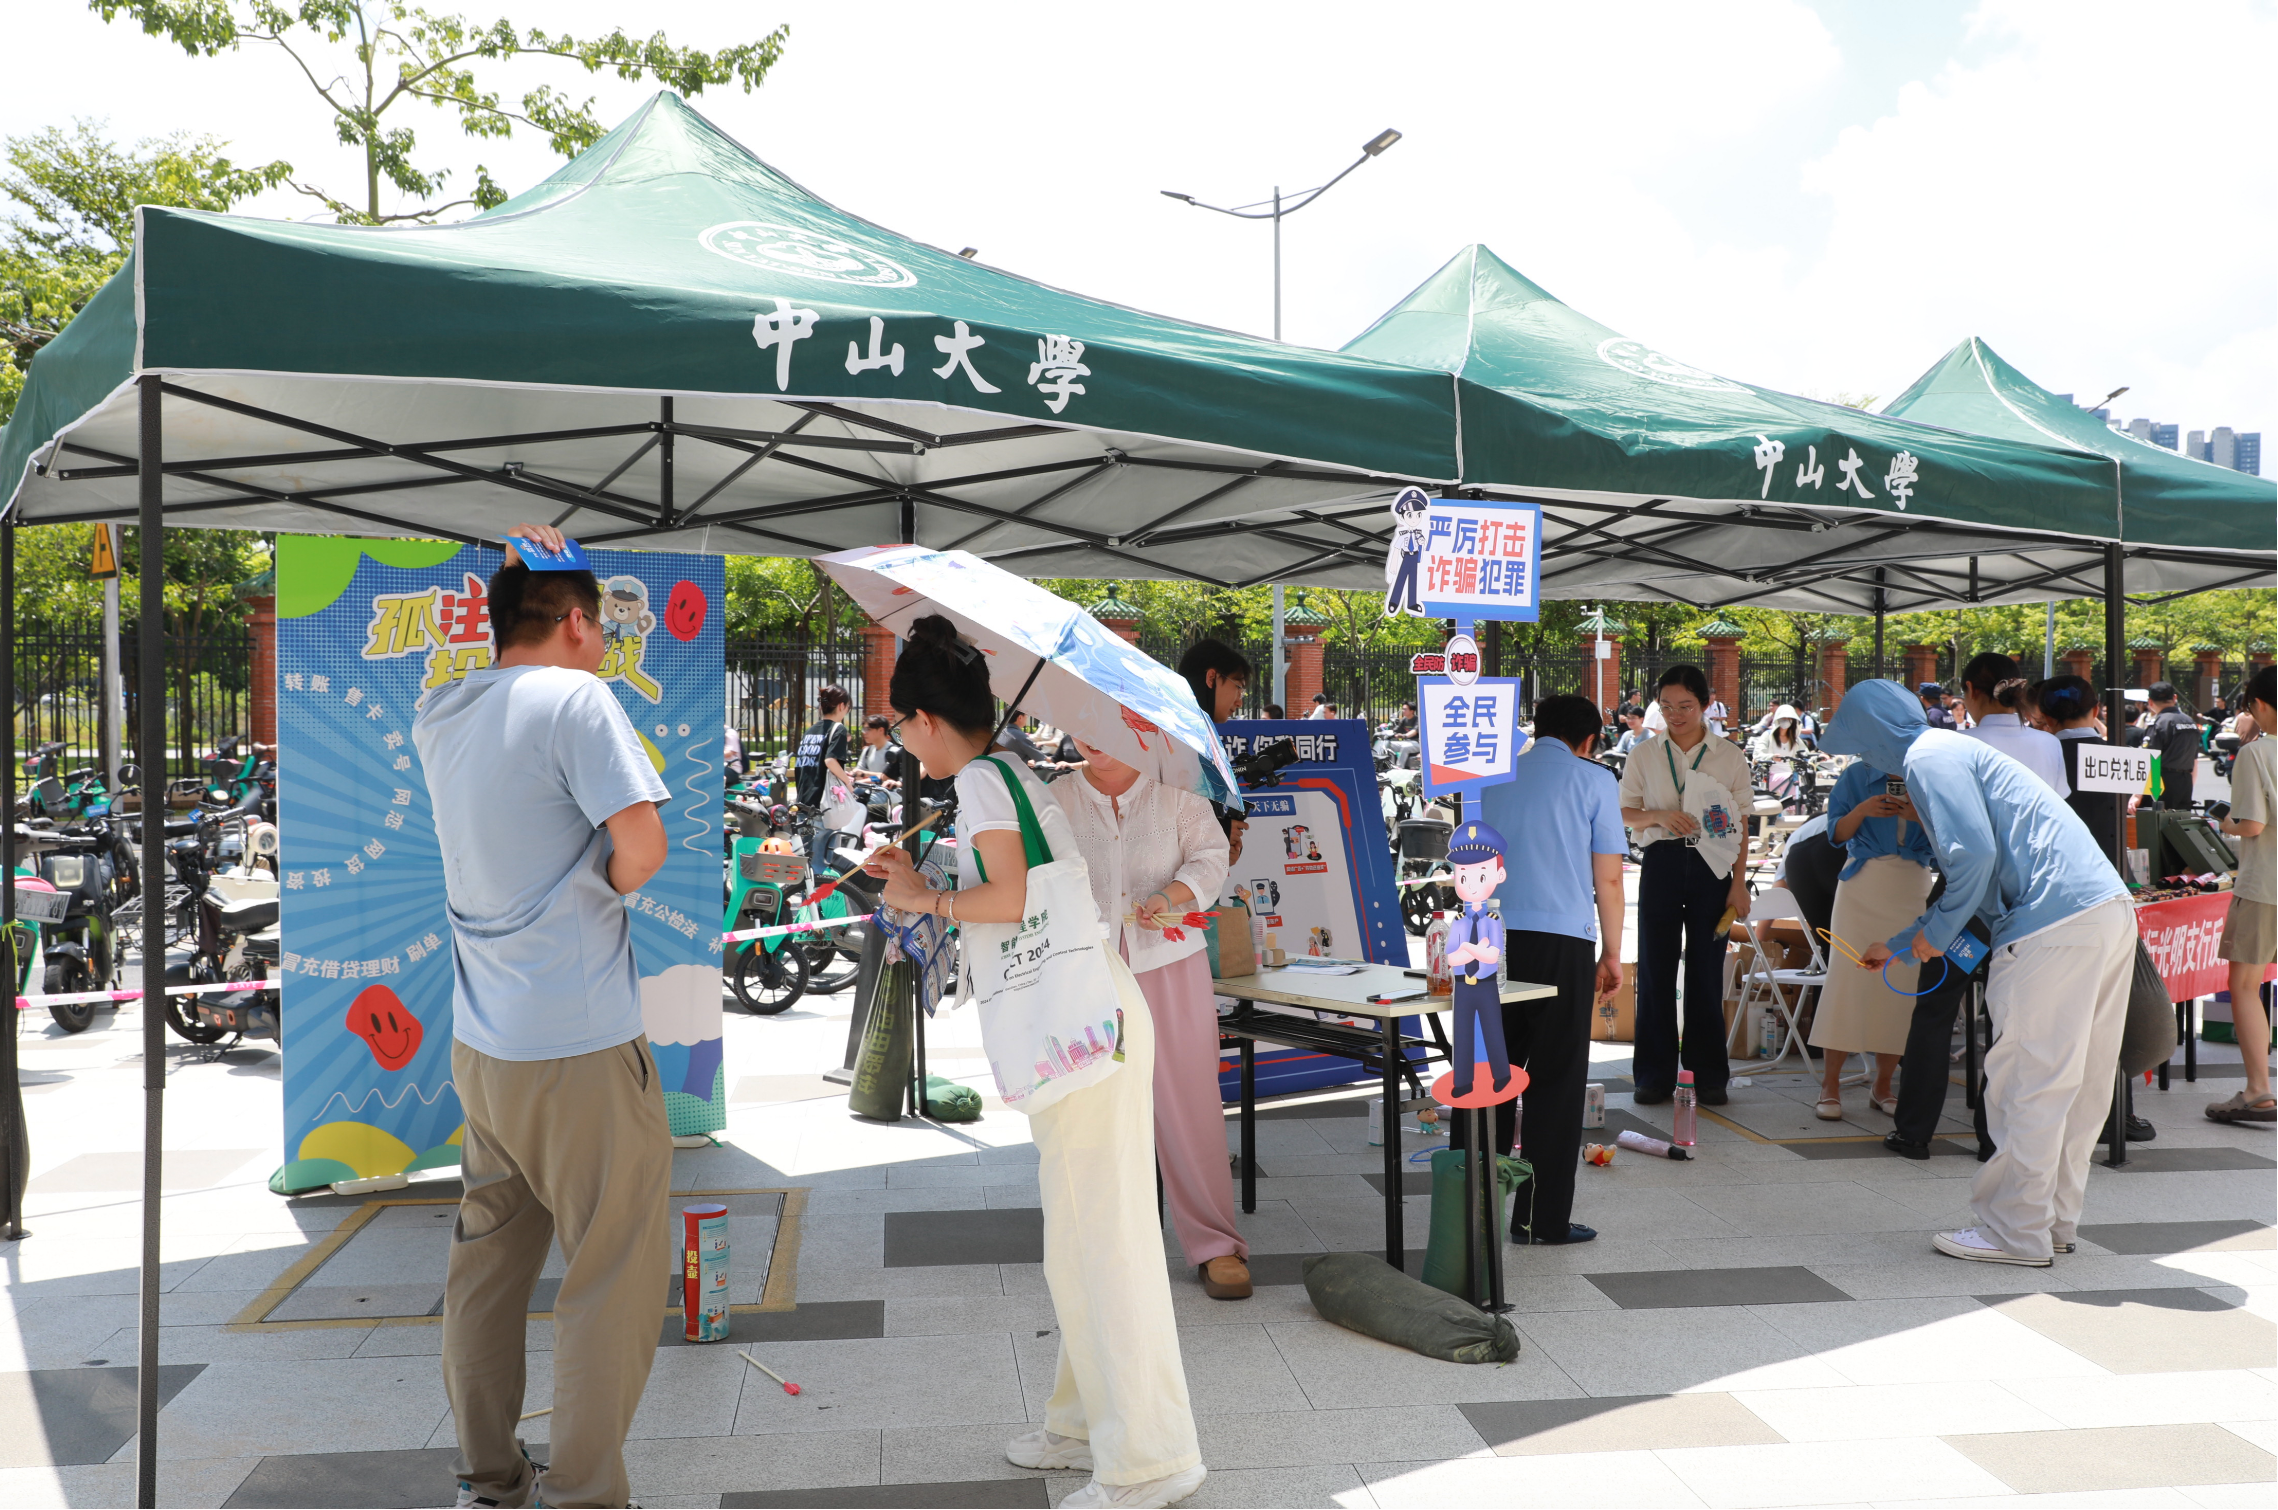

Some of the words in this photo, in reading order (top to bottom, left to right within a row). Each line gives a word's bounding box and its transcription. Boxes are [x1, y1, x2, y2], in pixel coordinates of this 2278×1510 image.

[752, 299, 1092, 414] 中山大學
[1754, 435, 1919, 511] 中山大學
[1426, 515, 1527, 558] 严厉打击
[1427, 554, 1526, 597] 诈骗犯罪
[285, 673, 331, 693] 转账
[1443, 695, 1497, 729] 全民
[1221, 735, 1248, 761] 诈
[1443, 731, 1498, 765] 参与
[2085, 756, 2147, 781] 出口兑礼品
[286, 868, 331, 890] 投资
[624, 891, 699, 939] 冒充公检法
[405, 932, 443, 963] 刷单
[281, 951, 400, 979] 冒充借贷理财
[686, 1250, 699, 1279] 投壶
